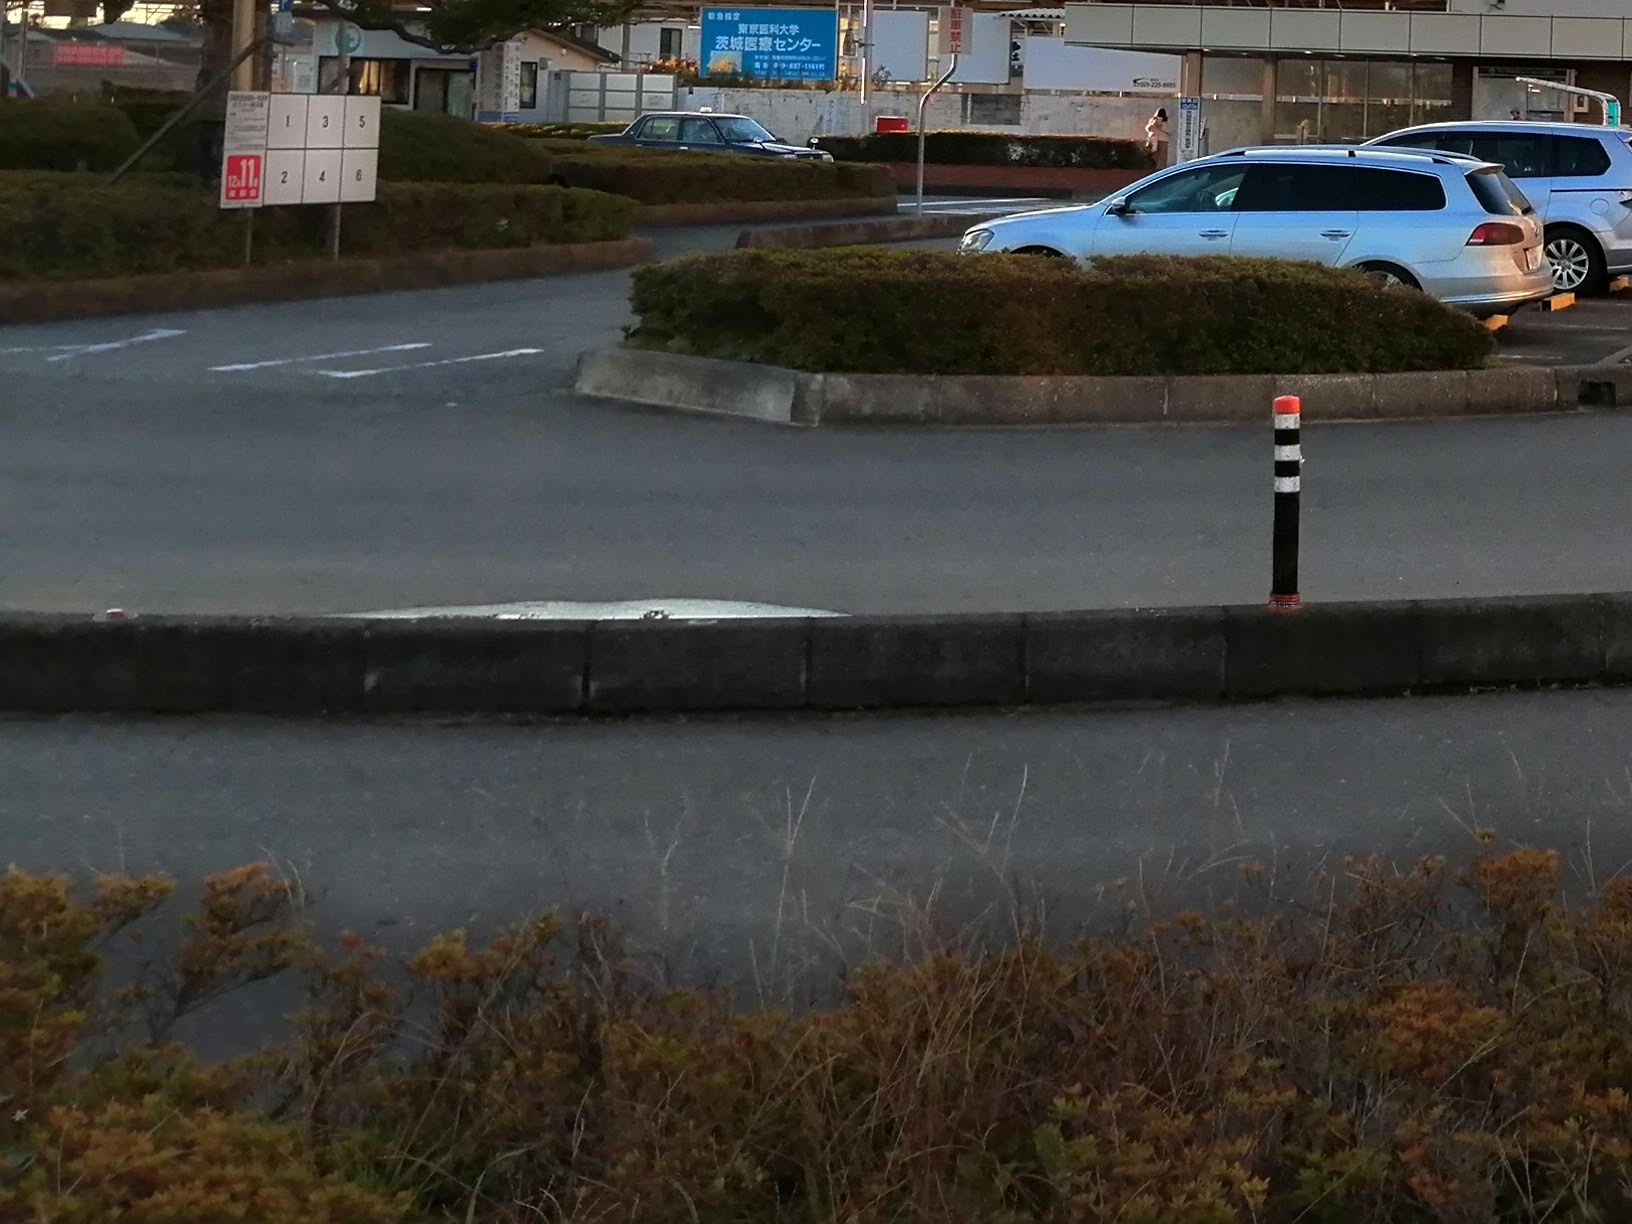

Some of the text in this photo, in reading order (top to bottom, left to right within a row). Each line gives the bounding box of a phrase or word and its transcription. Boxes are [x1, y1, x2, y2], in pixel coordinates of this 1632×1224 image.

[738, 23, 800, 36] 東京医科大学
[950, 7, 962, 54] 駐車禁止
[715, 35, 821, 52] 茨城医療センター
[285, 115, 291, 128] 1
[322, 115, 329, 128] 3
[359, 115, 366, 128] 5
[281, 171, 288, 184] 2
[319, 170, 326, 182] 4
[355, 169, 362, 182] 6
